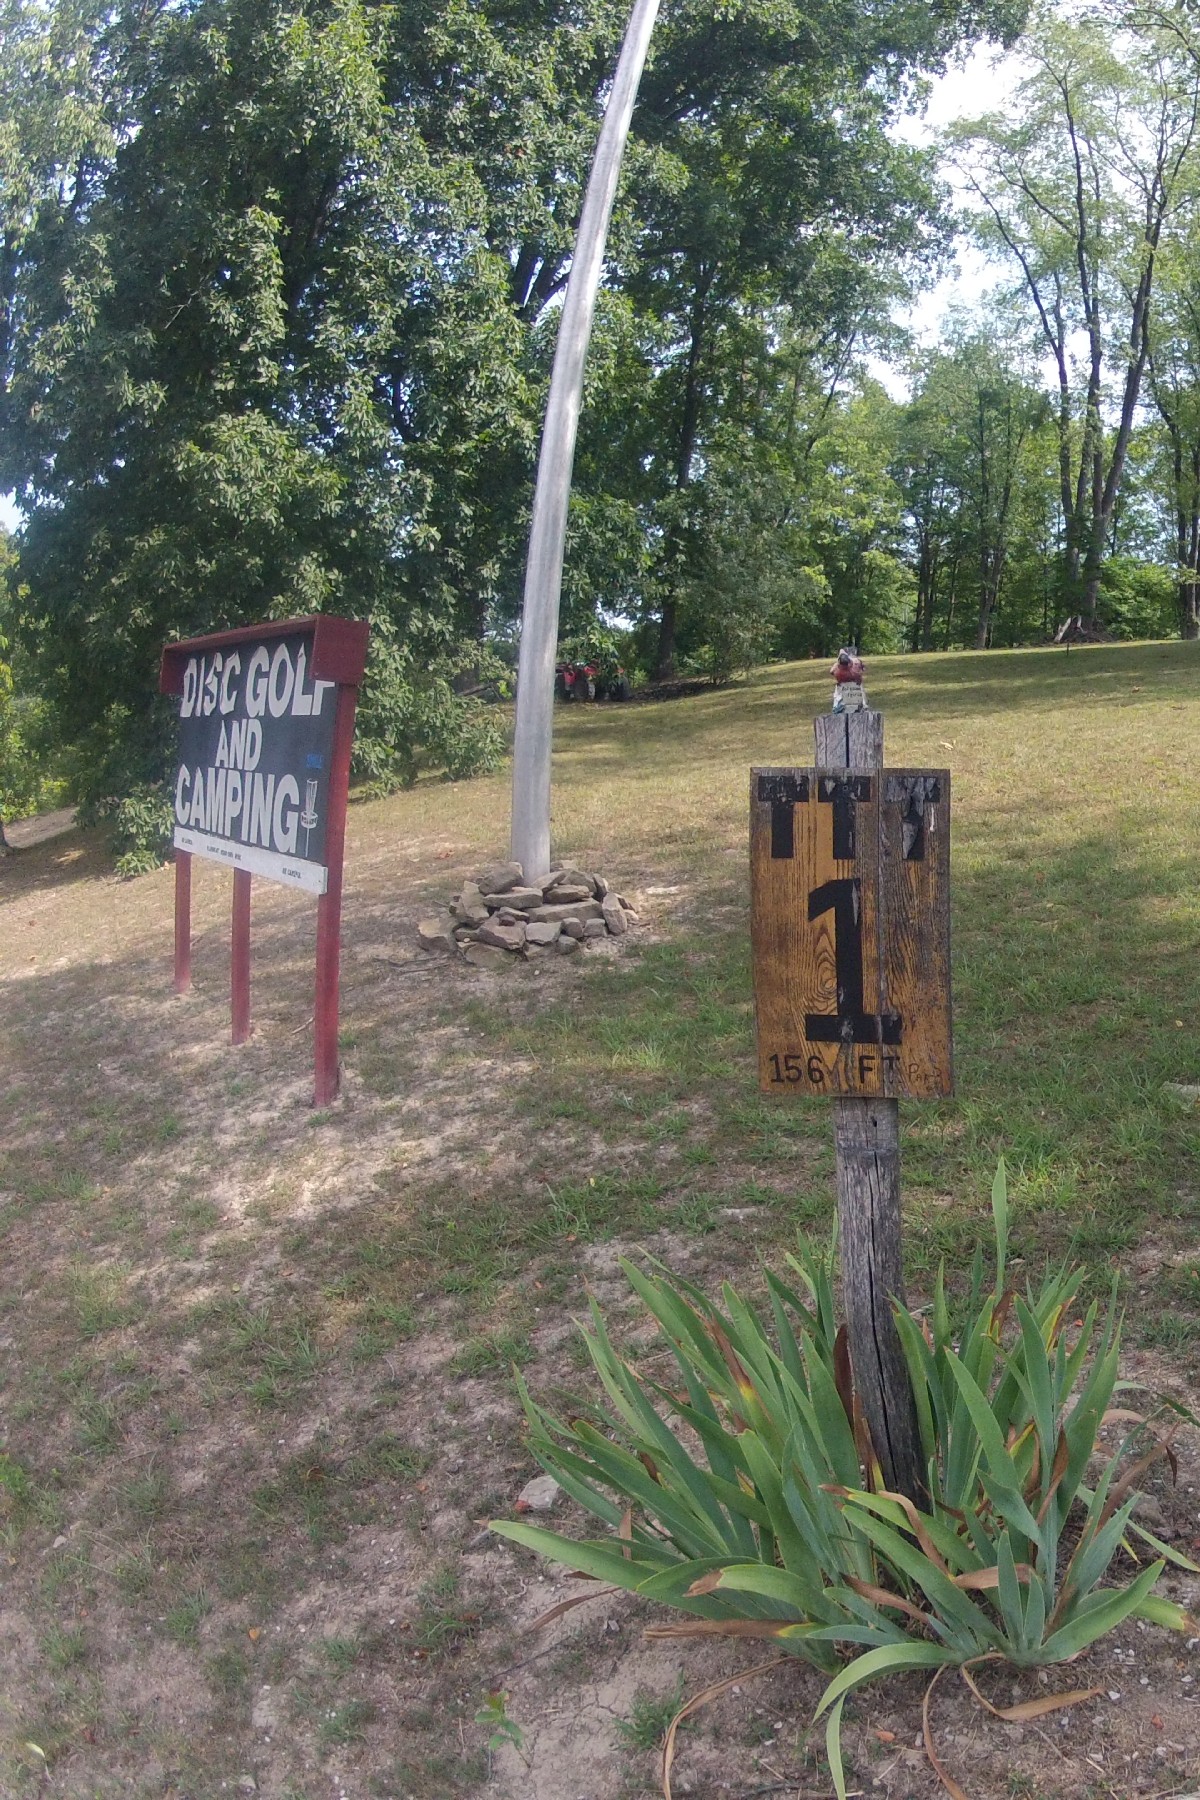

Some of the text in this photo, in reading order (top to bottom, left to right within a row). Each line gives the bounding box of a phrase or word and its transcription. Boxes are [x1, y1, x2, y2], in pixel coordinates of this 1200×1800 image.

[180, 651, 241, 717] DISC
[216, 719, 262, 770] AND
[175, 765, 299, 853] CAMPING
[807, 877, 903, 1045] 1
[768, 1053, 825, 1084] 156
